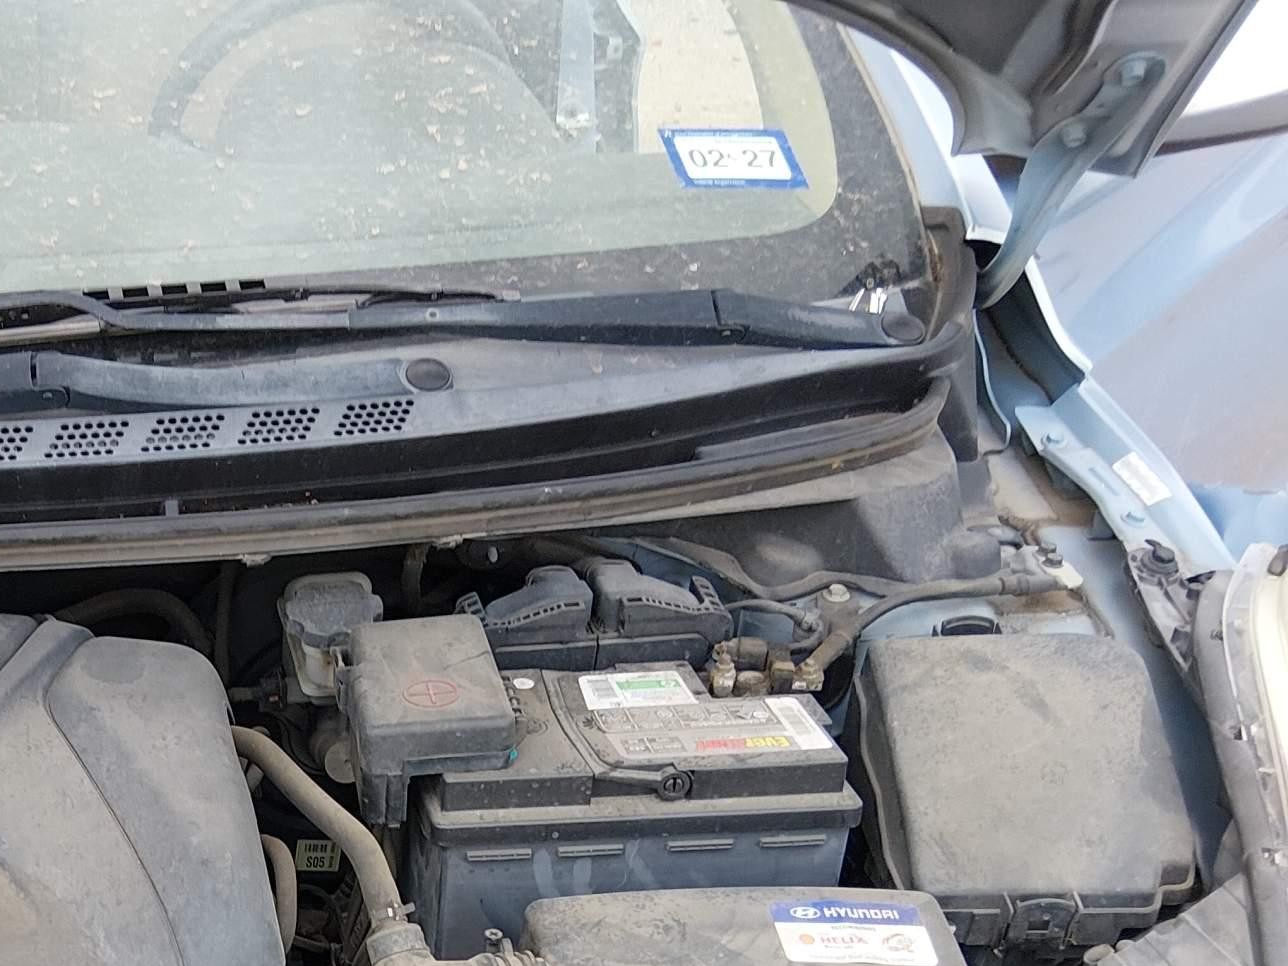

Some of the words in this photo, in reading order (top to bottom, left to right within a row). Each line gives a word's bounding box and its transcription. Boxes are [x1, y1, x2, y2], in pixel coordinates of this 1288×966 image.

[687, 148, 729, 168] 02
[742, 148, 776, 168] 27
[823, 906, 900, 920] HYUNDAI
